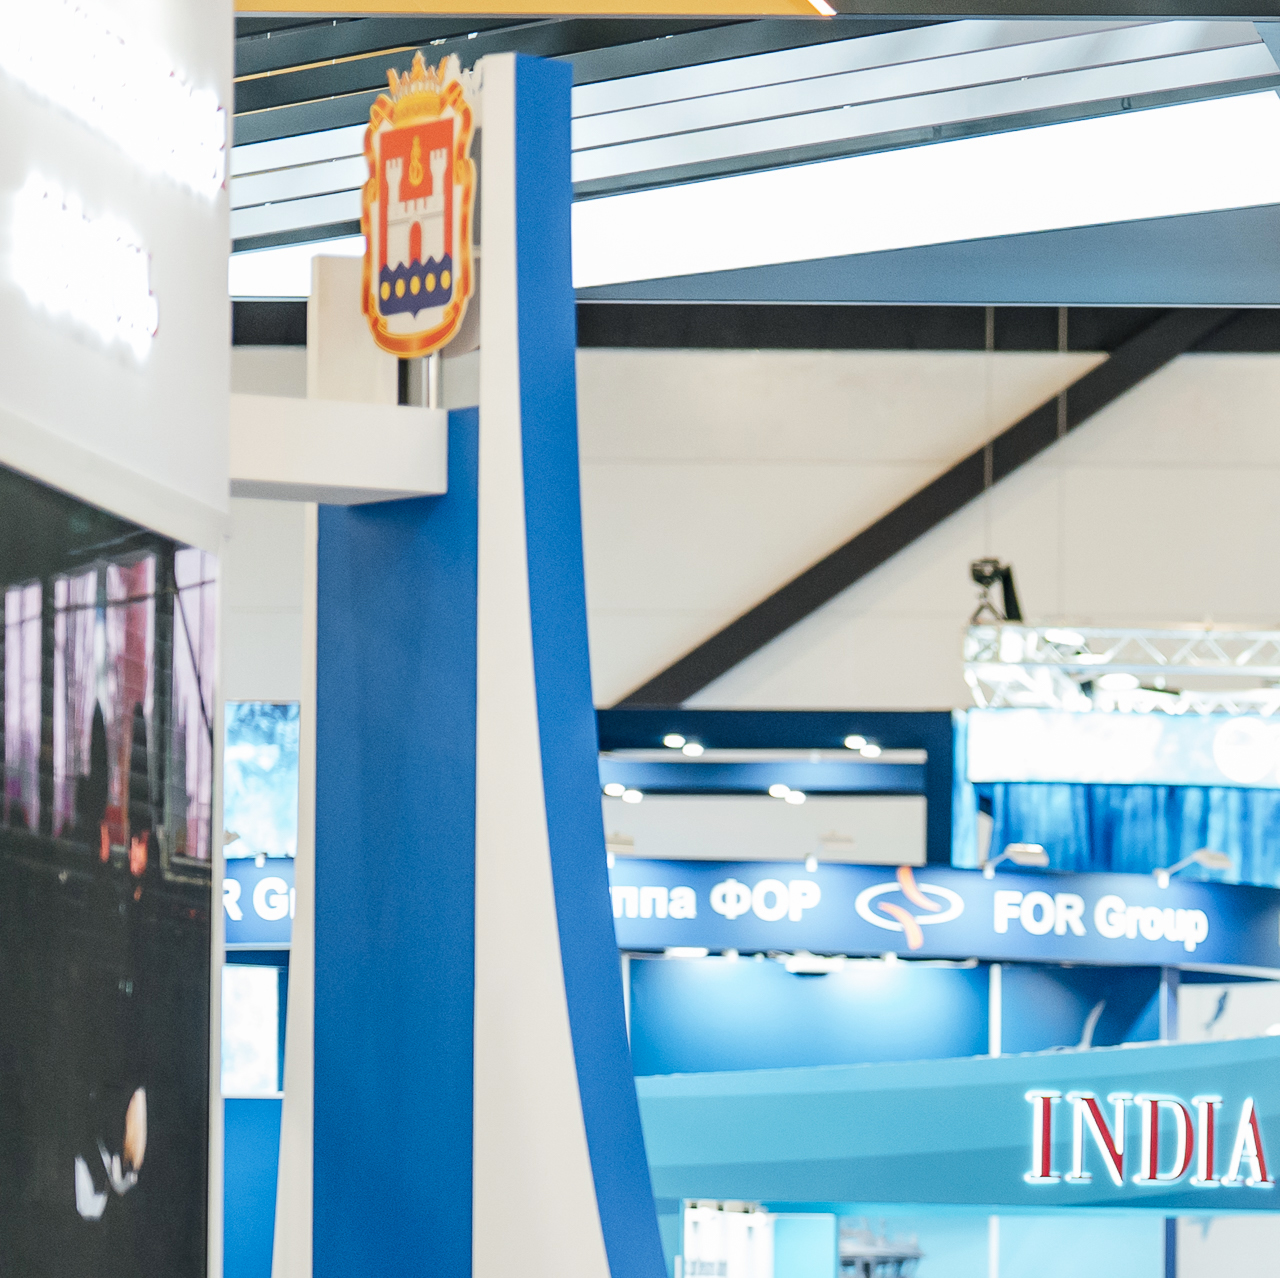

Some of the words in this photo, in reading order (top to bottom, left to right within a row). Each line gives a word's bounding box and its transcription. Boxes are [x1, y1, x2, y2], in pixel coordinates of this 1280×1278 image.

[609, 885, 697, 919] ппа
[709, 878, 822, 922] ФОР
[993, 889, 1087, 937] FOR
[1094, 894, 1209, 951] Group
[1024, 1089, 1276, 1188] INDIA
